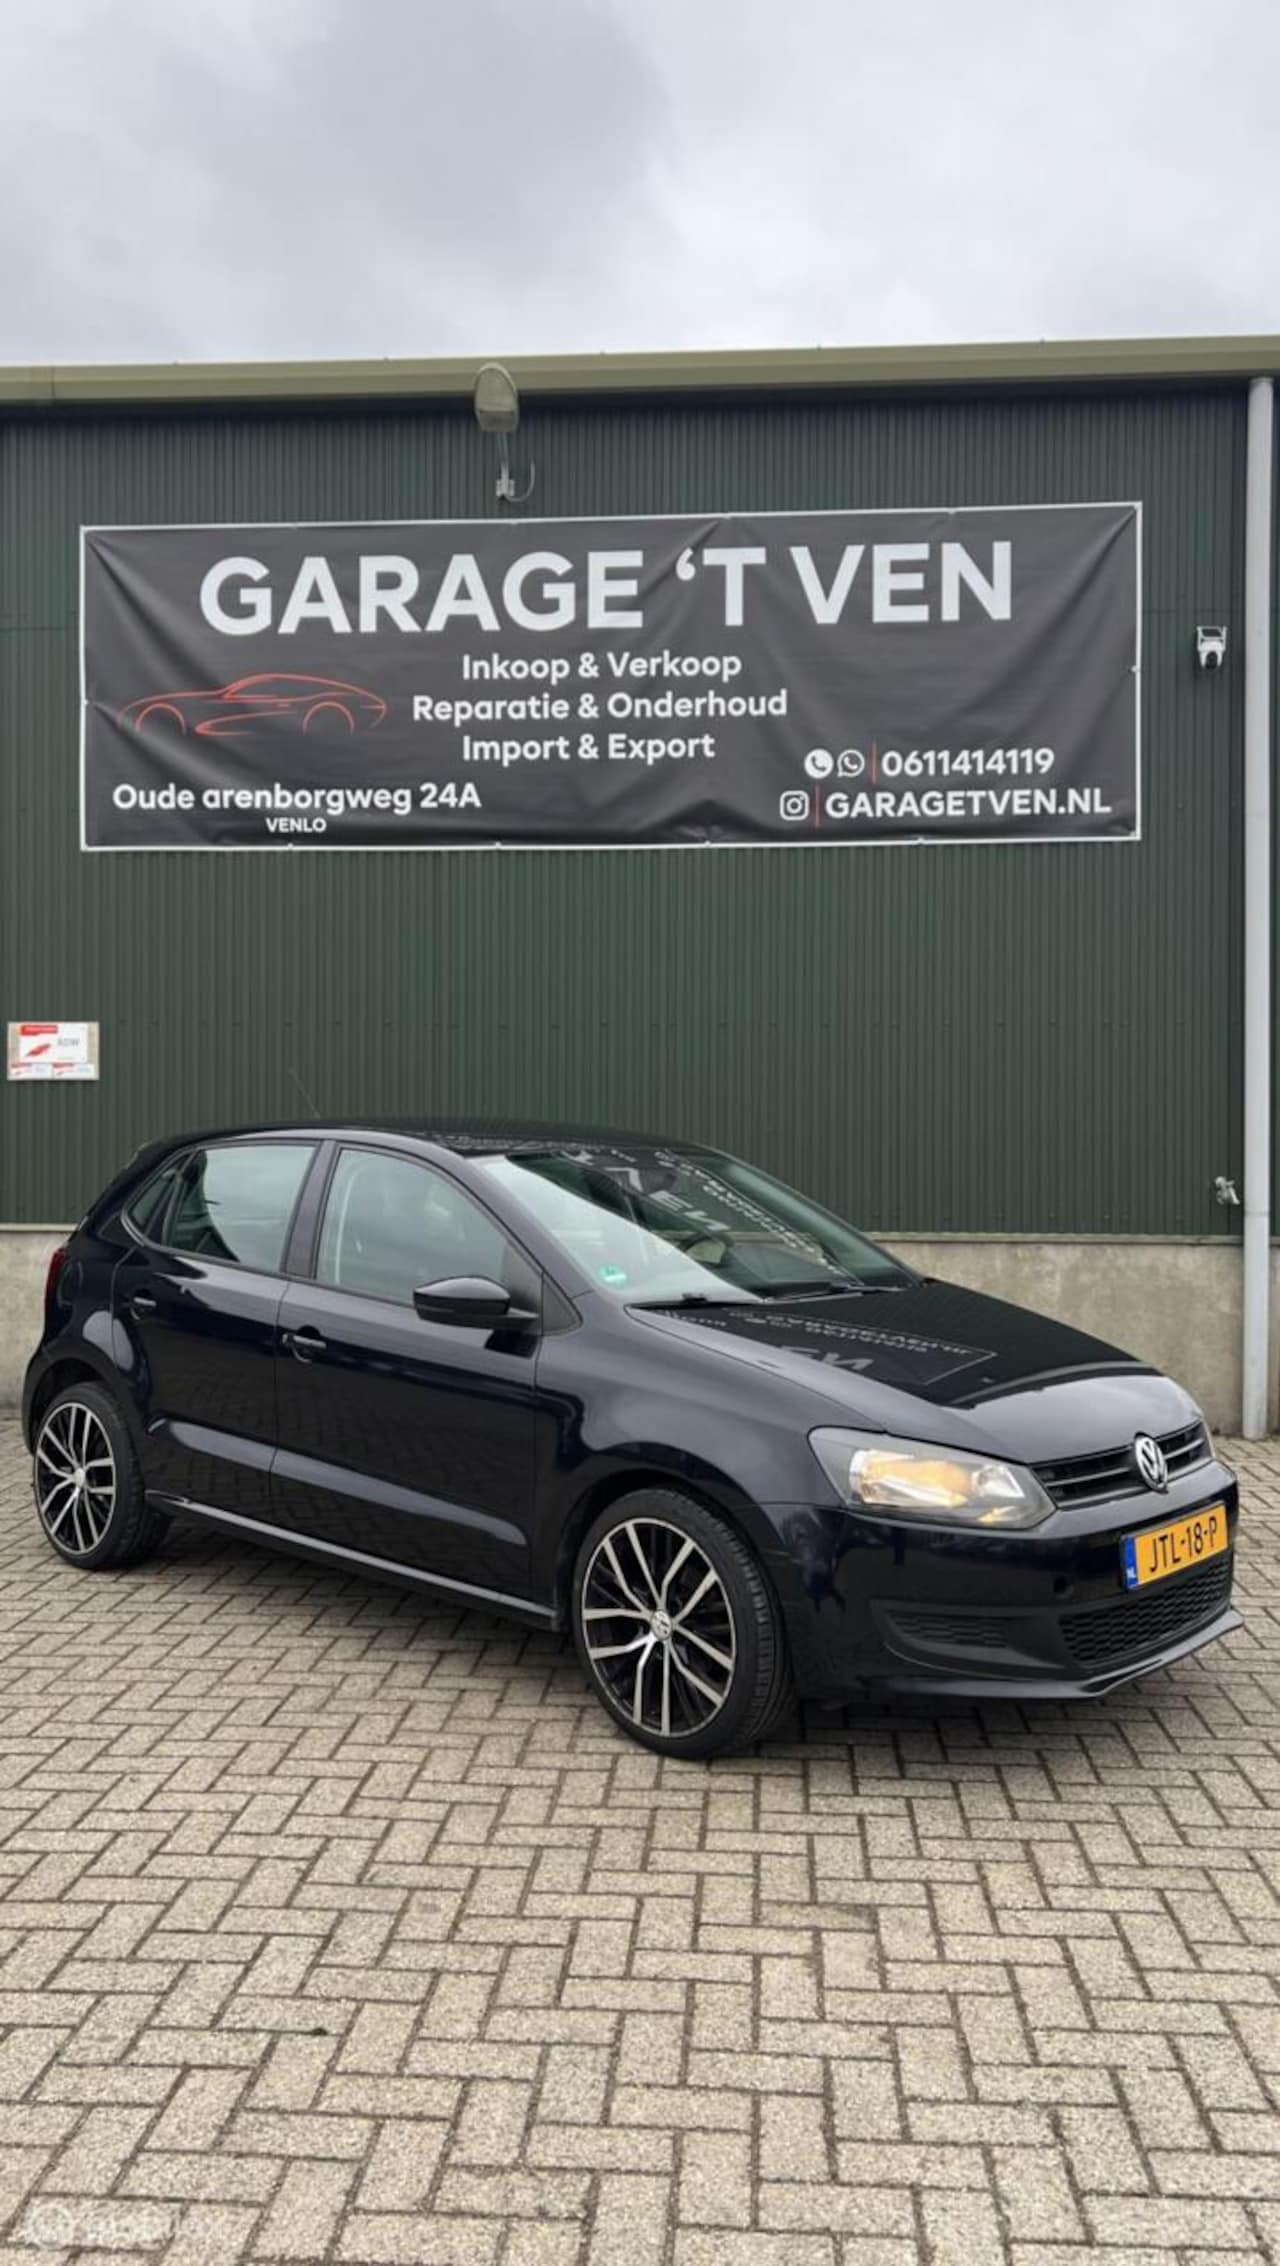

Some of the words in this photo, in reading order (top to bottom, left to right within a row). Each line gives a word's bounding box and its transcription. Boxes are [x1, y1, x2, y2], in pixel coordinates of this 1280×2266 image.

[200, 550, 643, 636] GARAGE
[789, 541, 1011, 625] VEN
[463, 653, 570, 686] Inkoop
[577, 652, 599, 679] &
[607, 650, 742, 683] Verkoop
[413, 692, 570, 727] Reparatie
[577, 693, 599, 719] &
[607, 689, 788, 718] Onderhoud
[463, 735, 570, 767] Import
[577, 733, 599, 759] &
[608, 733, 716, 766] Export
[881, 747, 1055, 777] 0611414119
[112, 783, 195, 810] Oude
[202, 783, 412, 814] arenborgweg
[420, 782, 482, 808] 24A
[825, 787, 1112, 819] GARAGETVEN.NL
[266, 816, 328, 834] VENLO
[1149, 1515, 1218, 1573] JTL-18-P
